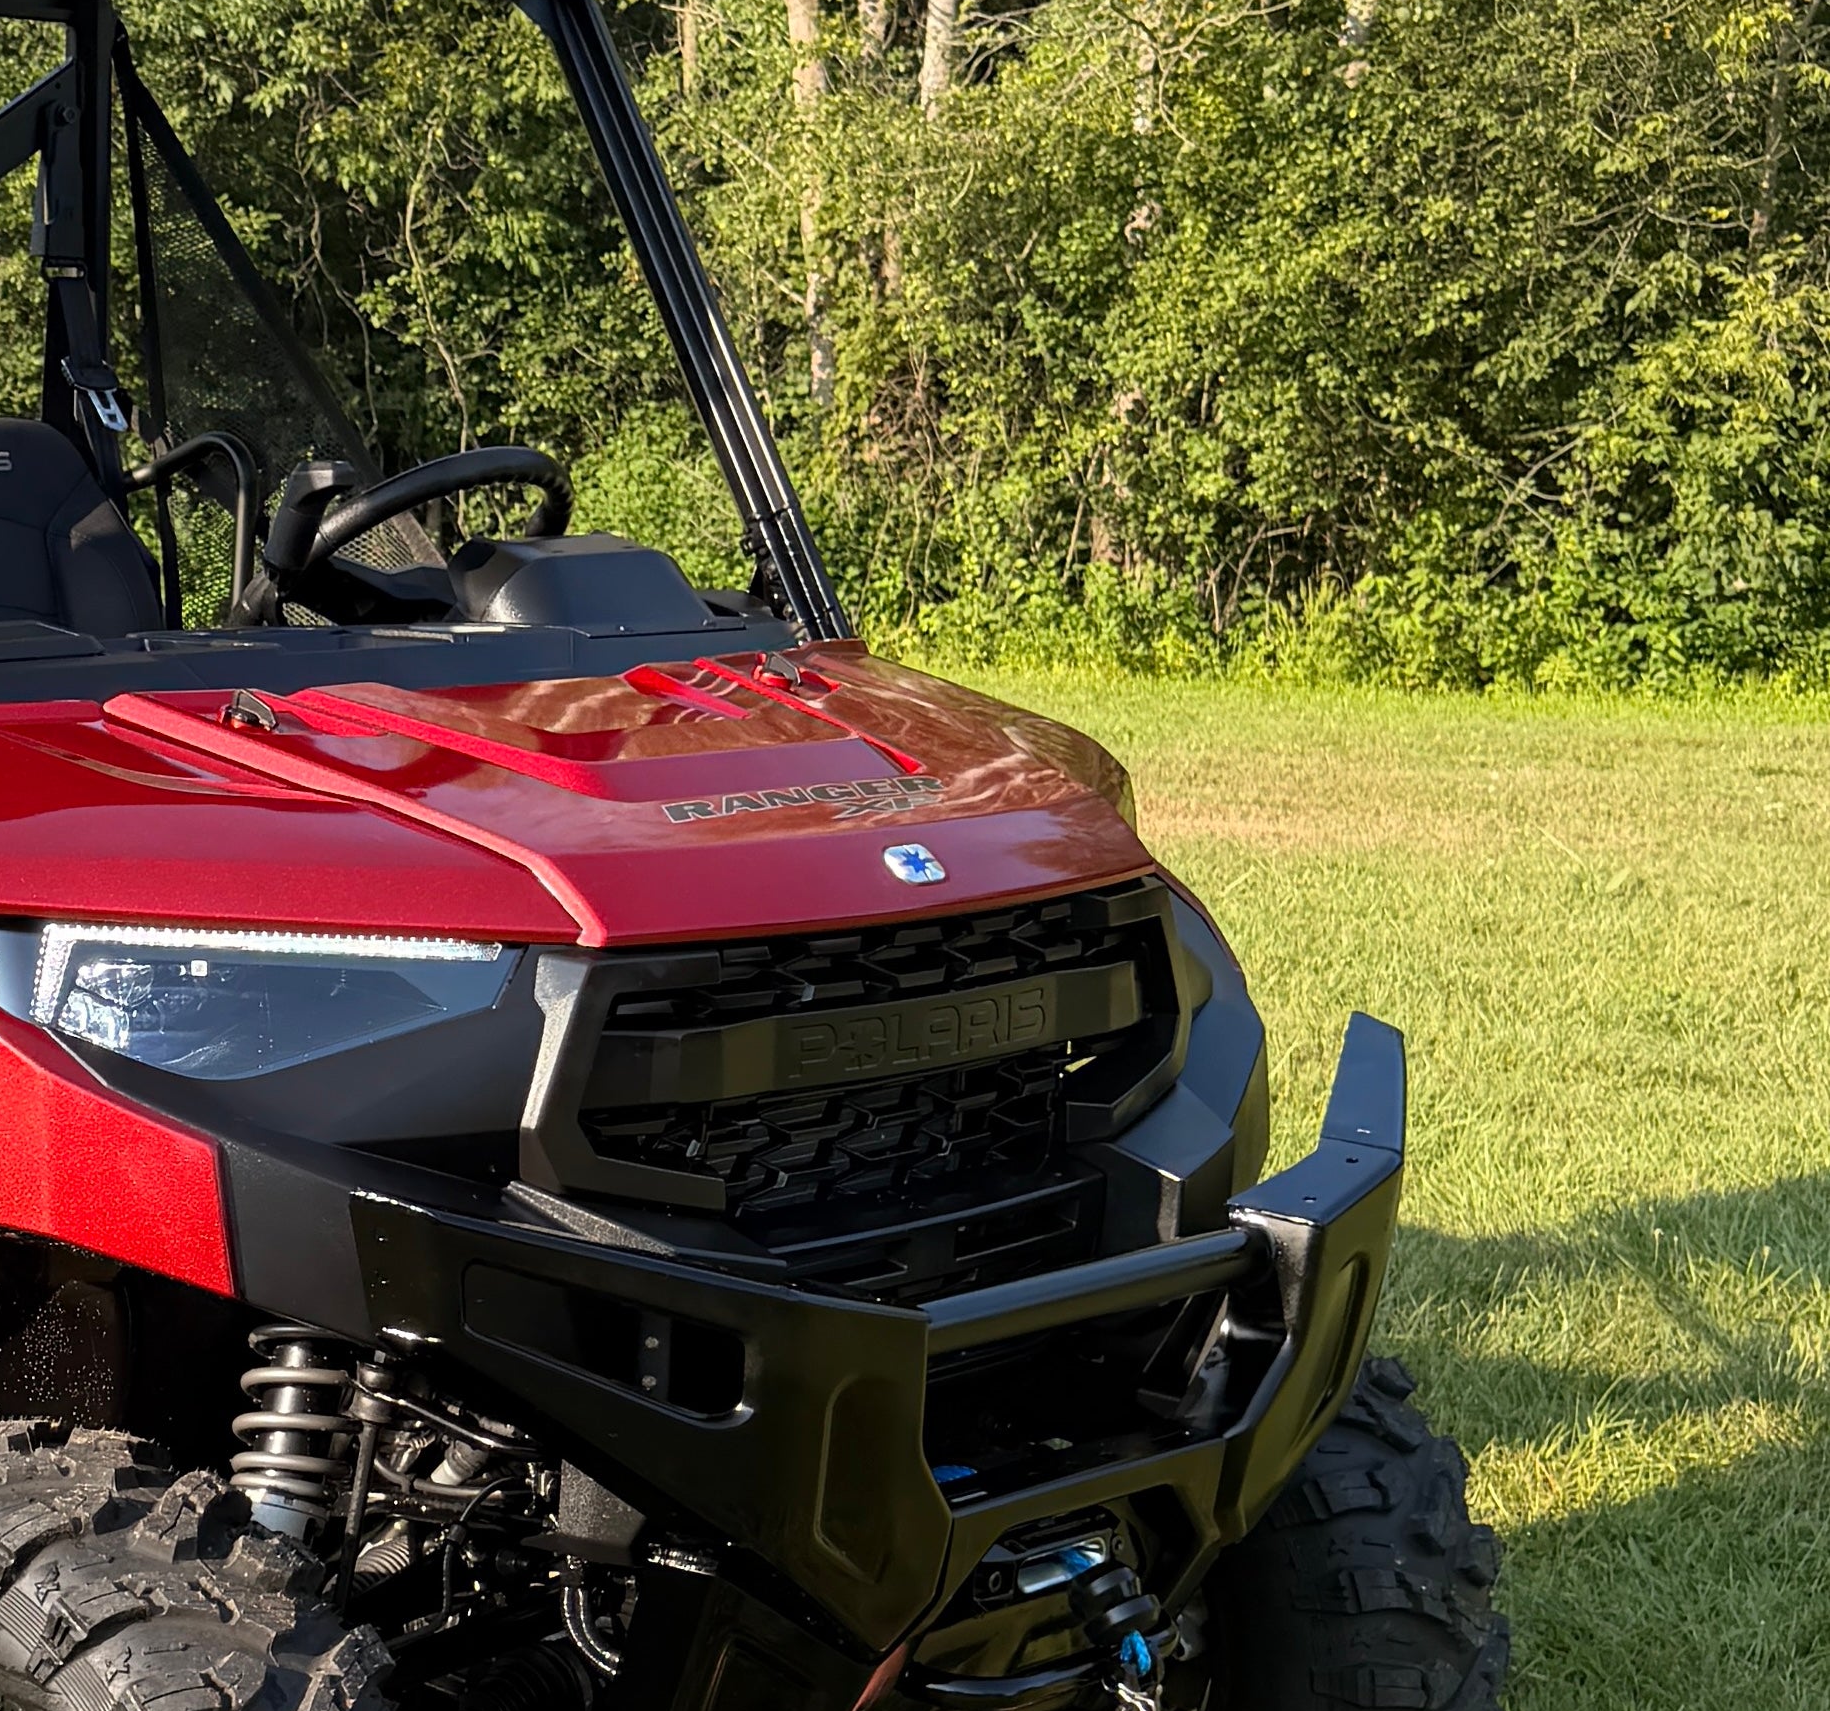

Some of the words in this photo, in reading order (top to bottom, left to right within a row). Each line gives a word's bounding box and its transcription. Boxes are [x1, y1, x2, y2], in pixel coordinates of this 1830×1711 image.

[661, 775, 946, 824] RANGER
[832, 792, 942, 821] XP
[788, 987, 1047, 1079] POLARIS
